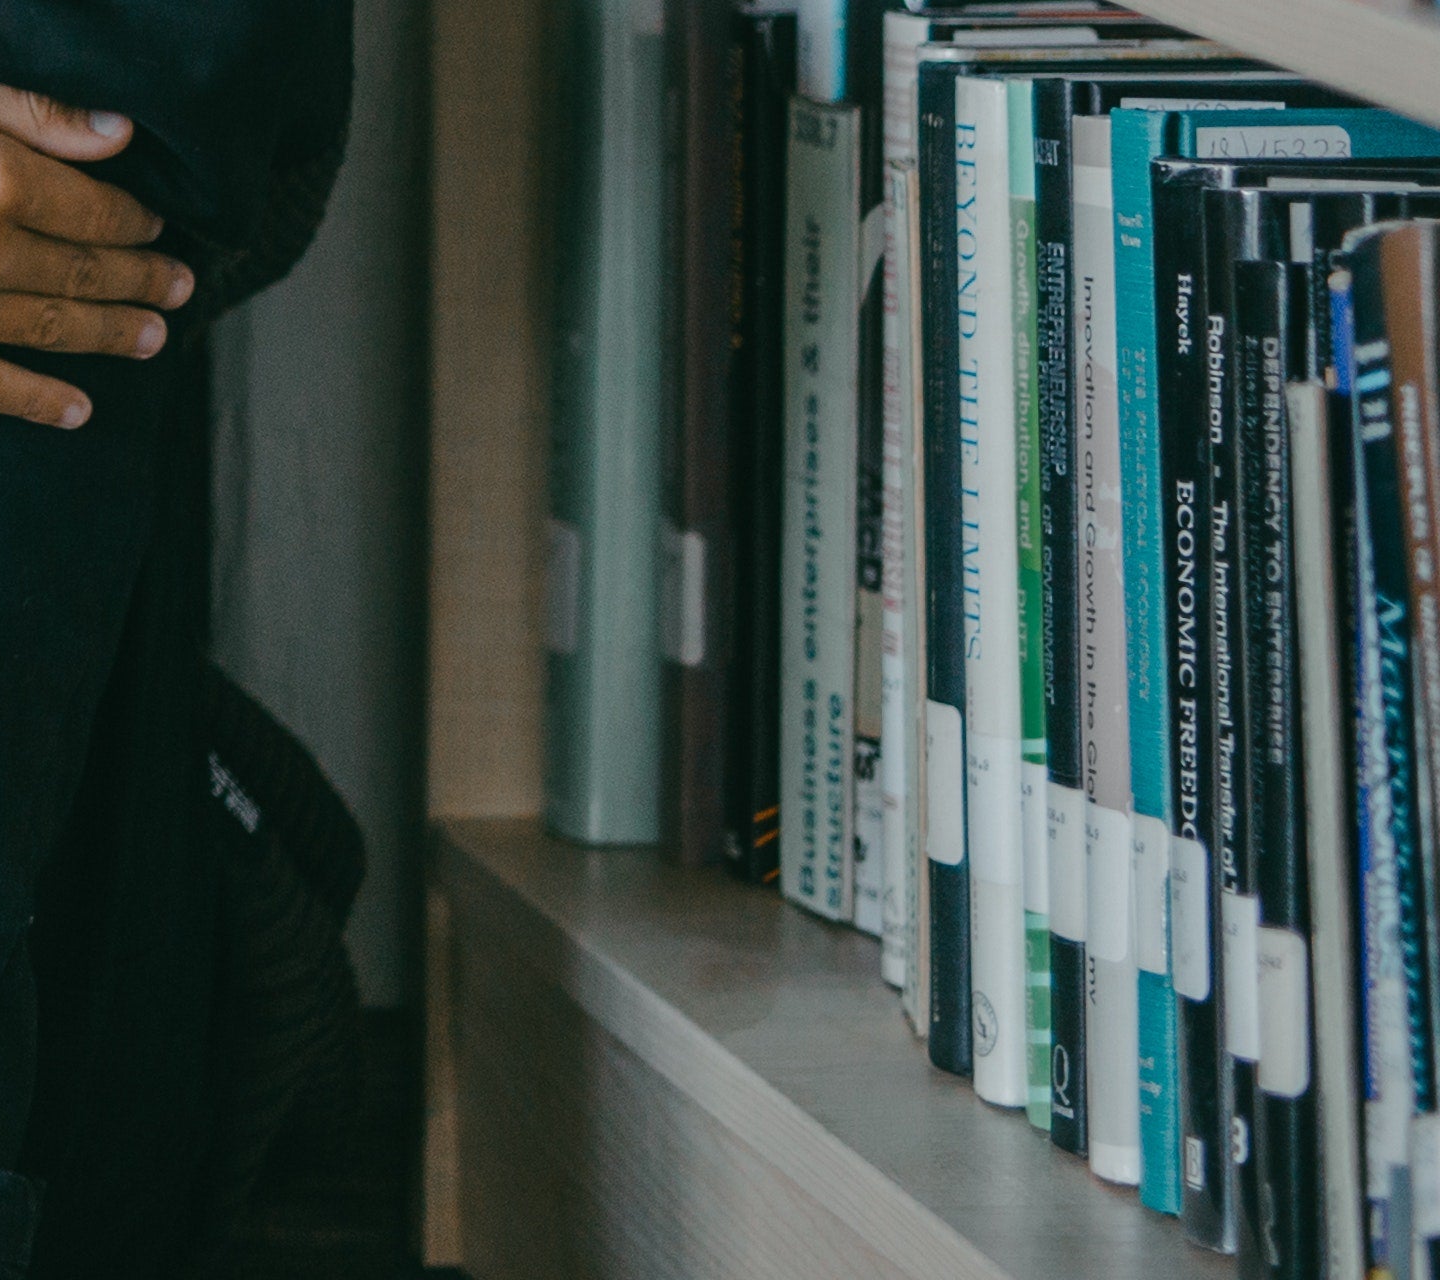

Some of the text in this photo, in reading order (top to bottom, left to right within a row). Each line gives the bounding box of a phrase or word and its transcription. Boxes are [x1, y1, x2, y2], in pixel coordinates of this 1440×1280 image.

[956, 121, 977, 340] BEYOND
[1038, 241, 1047, 293] AND
[1038, 305, 1048, 348] THE
[957, 359, 979, 466] THE
[1016, 219, 1032, 550] Growth, distribution, and
[1047, 242, 1066, 476] ENTREPRENEURSHIP
[799, 213, 823, 897] Business enterprises & their
[1042, 503, 1052, 534] OF
[1083, 275, 1097, 731] Innovation and Growth in the
[1175, 273, 1196, 686] Hayek ECONOMIC
[1262, 336, 1284, 765] DEPENDENCY TO ENTERPRISE
[1043, 546, 1054, 706] GOVERNMENT
[1207, 315, 1238, 877] Robinson The International Transfer of
[824, 690, 841, 911] structure
